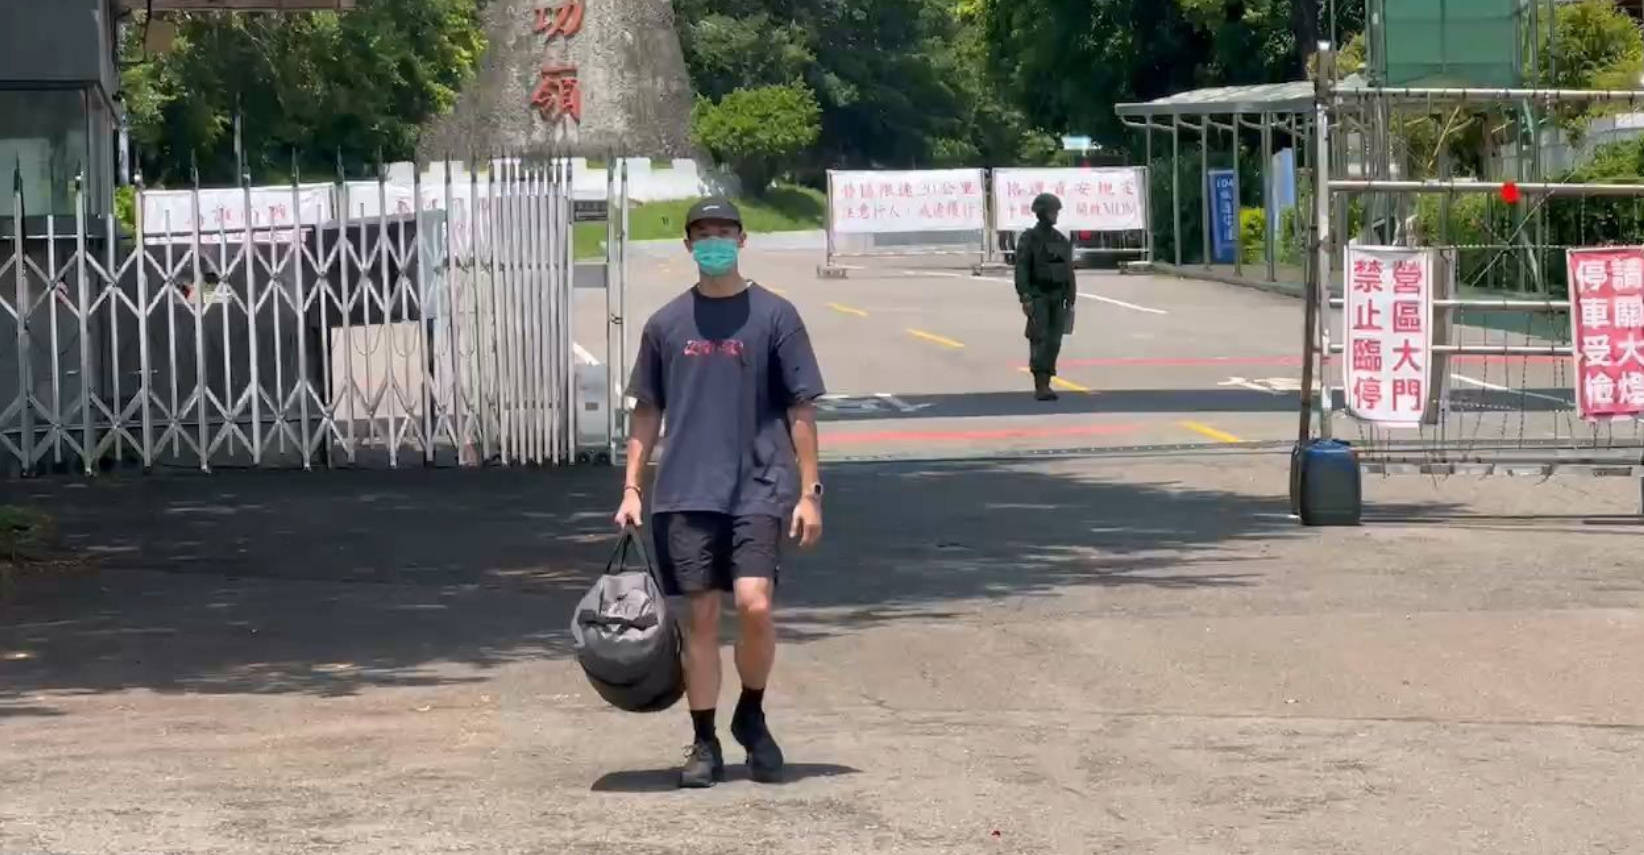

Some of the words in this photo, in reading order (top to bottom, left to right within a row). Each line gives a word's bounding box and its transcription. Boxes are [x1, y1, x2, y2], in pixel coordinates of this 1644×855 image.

[1353, 259, 1384, 410] 禁止臨停
[1392, 260, 1423, 412] 營區大門
[1576, 260, 1616, 409] 停車受檢
[1610, 257, 1644, 405] 請關大燈
